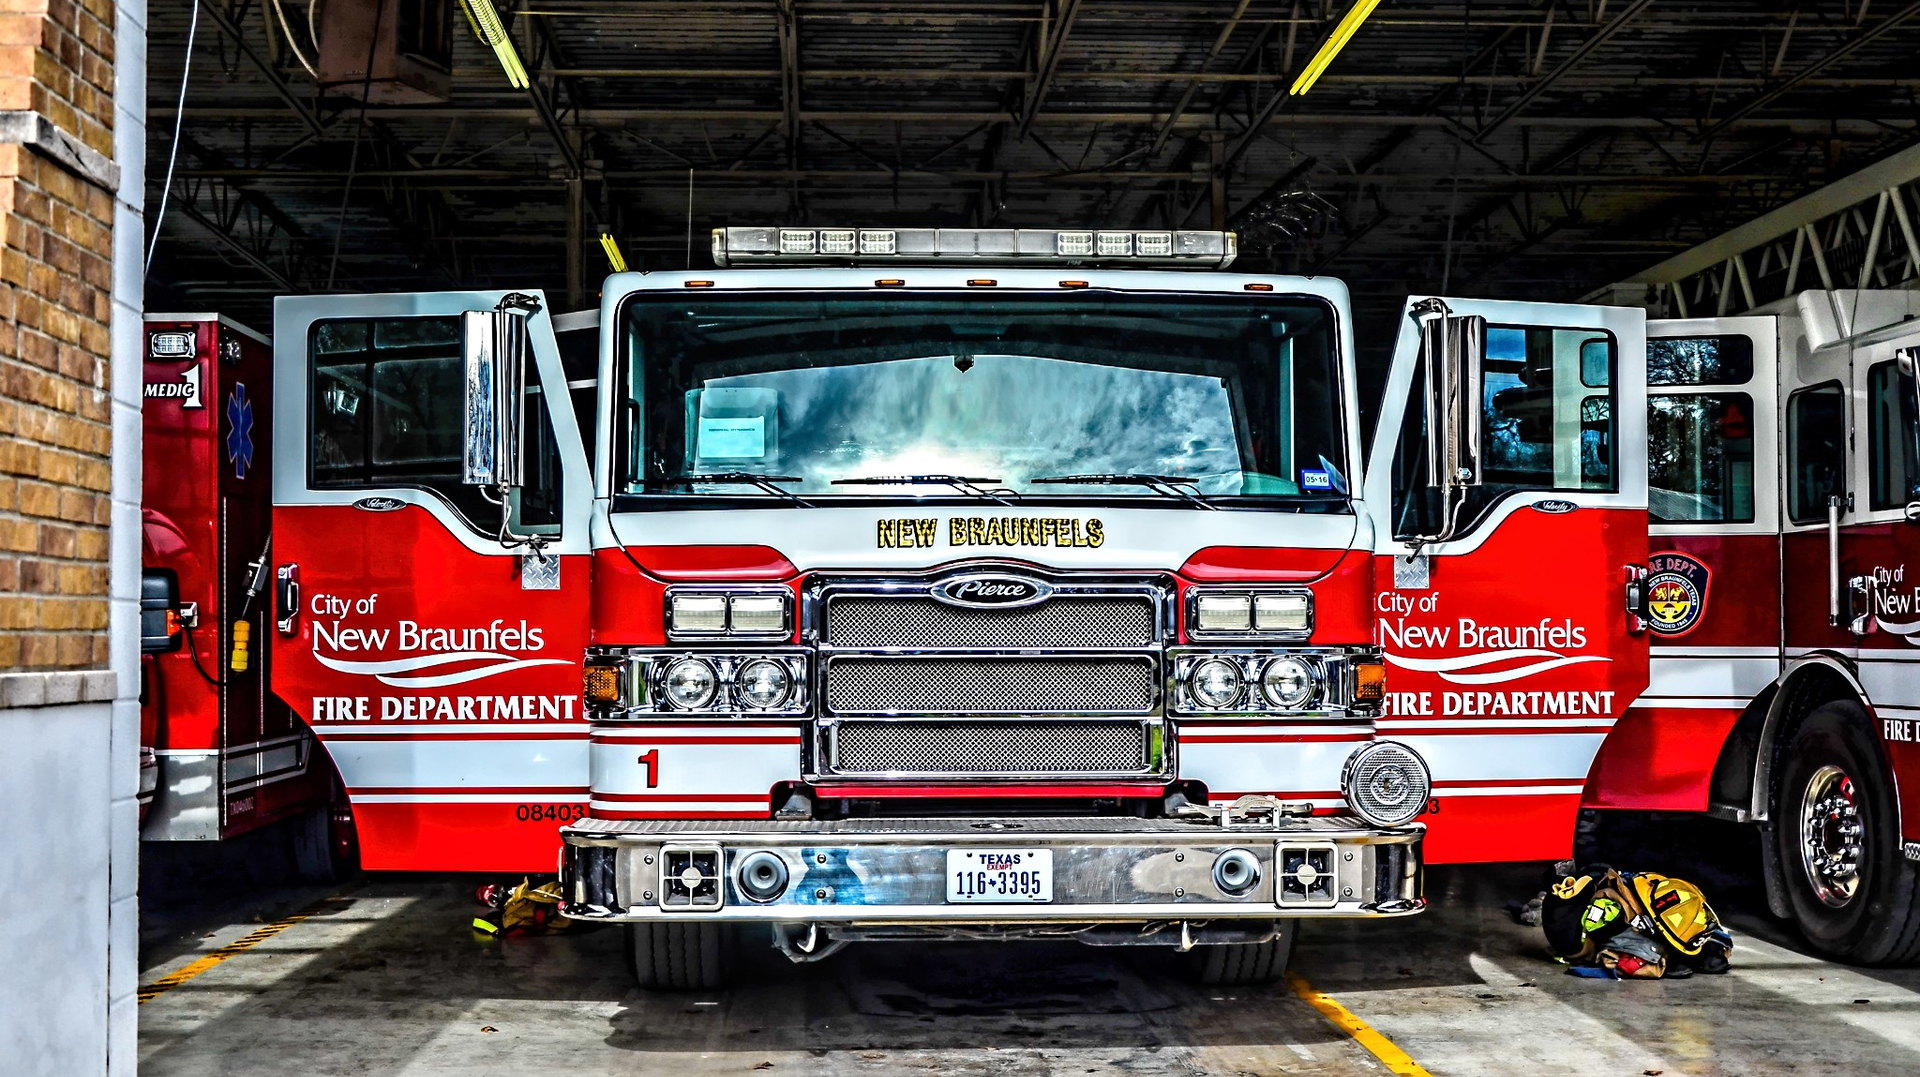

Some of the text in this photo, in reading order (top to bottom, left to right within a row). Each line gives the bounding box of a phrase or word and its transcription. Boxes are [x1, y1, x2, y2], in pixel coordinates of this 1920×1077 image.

[144, 363, 203, 409] MEDIC 1
[877, 517, 1105, 549] NEW BRAUNFELS
[1893, 563, 1905, 582] of
[955, 580, 1027, 599] Pierce
[1874, 588, 1912, 615] New
[311, 593, 378, 619] City of
[1377, 591, 1440, 617] City of
[311, 619, 545, 651] New Braunfels
[1378, 617, 1587, 649] New Braunfels
[312, 695, 578, 721] FIRE DEPARTMENT
[1382, 690, 1616, 716] FIRE DEPARTMENT
[1883, 719, 1912, 742] FIRE
[637, 748, 659, 789] 1
[516, 804, 585, 822] 08403
[978, 853, 1021, 865] TEXAS
[986, 863, 1013, 871] EXEMPT
